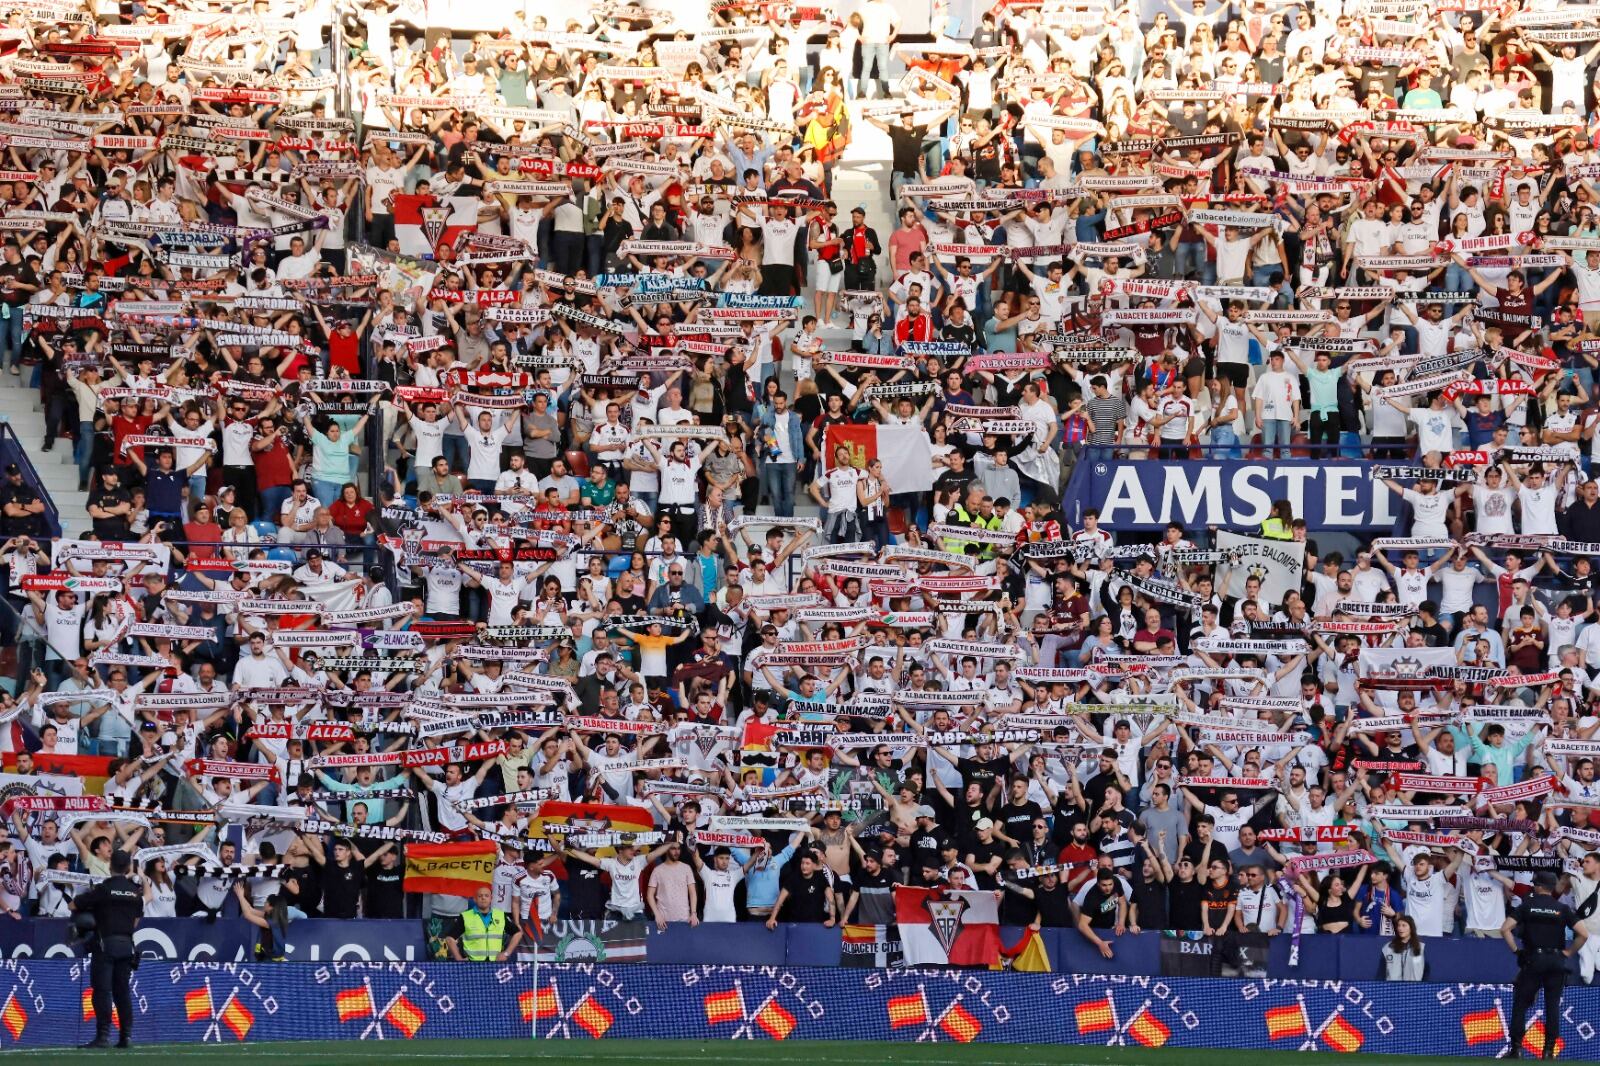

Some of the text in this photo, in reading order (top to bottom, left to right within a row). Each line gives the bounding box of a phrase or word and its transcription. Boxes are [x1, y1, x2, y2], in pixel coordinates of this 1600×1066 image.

[36, 11, 83, 21] AUPA ALBA
[1538, 31, 1568, 40] ALBACETE
[285, 119, 313, 128] ALBACETE
[630, 125, 710, 135] AUPA ALBA
[103, 137, 147, 147] AUPA ALBA
[1166, 138, 1193, 147] ALBACETE
[520, 160, 598, 176] AUPA ALBA
[503, 184, 531, 192] ALBACETE
[945, 202, 975, 210] ALBACETE
[1462, 235, 1510, 249] AUPA ALBA
[937, 244, 965, 253] ALBACETE
[1523, 256, 1556, 264] ALBACETE
[646, 278, 697, 290] ALBACETE
[432, 289, 513, 301] AUPA ALBA
[730, 294, 789, 306] ALBACETE
[714, 310, 778, 318] ALBACETE BALOMPIE
[1254, 312, 1287, 320] ALBACETE
[679, 326, 708, 334] ALBACETE
[218, 335, 254, 346] CURVA
[834, 354, 866, 365] ALBACETE
[583, 375, 609, 385] ALBACETE
[321, 381, 371, 391] AUPA ALBA
[127, 435, 205, 446] QUIJOTE BLANCO
[1100, 466, 1397, 525] AMSTEL
[1552, 541, 1588, 551] ALBACETE
[200, 559, 277, 570] MANCHA BLANCA
[831, 563, 864, 574] ALBACETE
[34, 578, 107, 588] MANCHA BLANCA
[242, 601, 276, 610] ALBACETE
[899, 615, 927, 623] BLANCA
[1323, 622, 1357, 631] ALBACETE
[497, 628, 543, 636] ALBACETE
[278, 634, 312, 643] ALBACETE
[384, 634, 409, 645] BLANCA
[787, 643, 821, 652] ALBACETE
[933, 642, 969, 650] ALBACETE
[1217, 641, 1251, 649] ALBACETE
[464, 648, 499, 656] albacete
[335, 659, 380, 667] ALBACETE
[770, 656, 806, 664] ALBACETE
[1016, 668, 1050, 677] ALBACETE
[1491, 675, 1523, 686] ALBACETE
[151, 696, 187, 704] ALBACETE
[795, 700, 826, 712] GRADA
[1474, 709, 1506, 717] ALBACETE
[583, 717, 617, 729] ALBACETE
[1365, 718, 1401, 727] ALBACETE
[251, 725, 351, 737] AUPA ALBA
[933, 731, 1040, 744] ABP FANS
[1216, 733, 1254, 742] ALBACETE
[1551, 743, 1587, 751] ALBACETE
[405, 743, 507, 765] AUPA ALBA
[327, 755, 363, 764] ALBACETE
[1193, 777, 1230, 785] ALBACETE
[1402, 779, 1429, 787] LOCURA
[1455, 781, 1474, 789] ALBA
[1532, 781, 1551, 792] ALBA
[360, 825, 401, 838] FANS
[1260, 828, 1300, 839] AUPA
[1388, 830, 1423, 840] ALBACETE
[407, 859, 493, 876] ALBACETE
[1497, 857, 1528, 868] ALBACETE
[1017, 864, 1058, 879] GATE
[843, 941, 899, 953] ALBACETE CITY
[1180, 942, 1248, 959] BAR X
